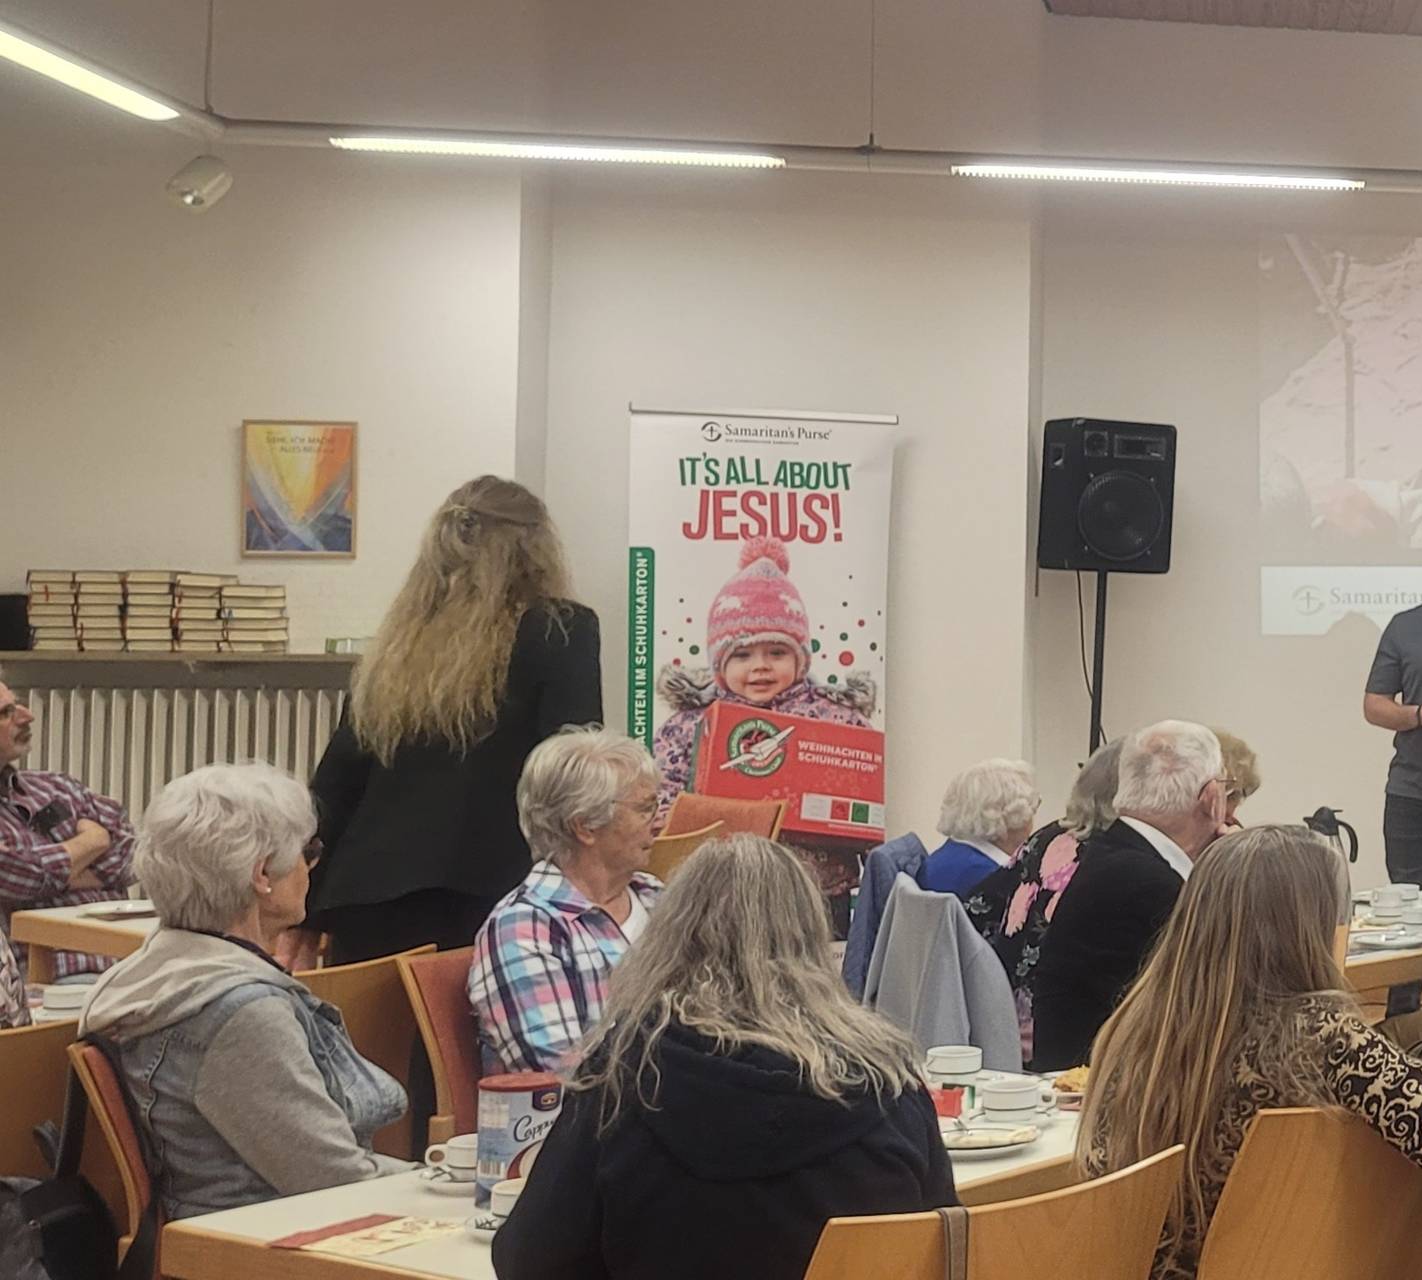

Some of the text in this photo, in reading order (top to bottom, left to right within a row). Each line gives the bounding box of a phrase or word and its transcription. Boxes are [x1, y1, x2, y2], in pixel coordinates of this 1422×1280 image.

[725, 424, 830, 440] Samaritan's Purse
[679, 452, 852, 490] IT'S ALL ABOUT
[682, 489, 843, 544] JESUS!
[635, 668, 647, 685] IM
[634, 689, 647, 746] ACHTEN
[798, 740, 873, 762] WEIHNACHTEN
